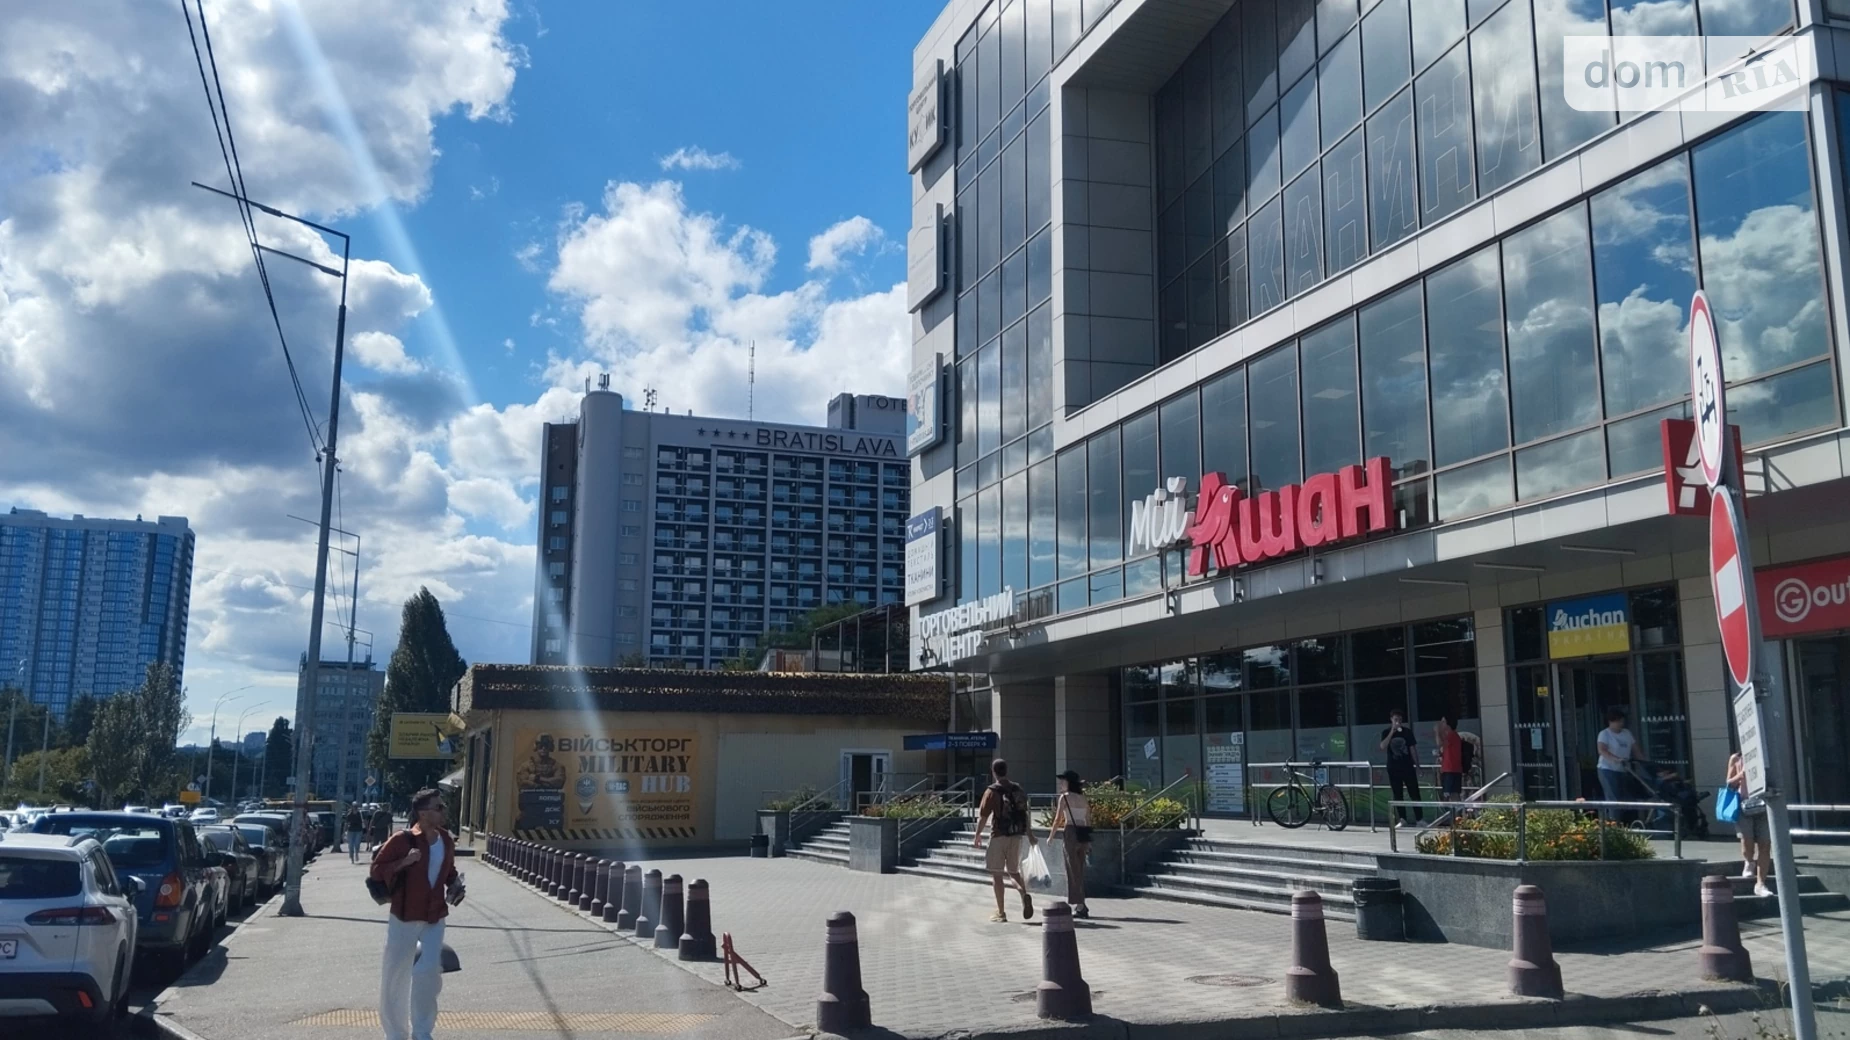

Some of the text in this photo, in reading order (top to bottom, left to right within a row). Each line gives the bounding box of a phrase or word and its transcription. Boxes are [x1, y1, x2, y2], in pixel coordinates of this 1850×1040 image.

[757, 428, 897, 456] BRATISLAVA
[919, 585, 1014, 640] ТОРГОВЕЛЬНИЙ
[1553, 608, 1625, 632] Auchan
[941, 629, 984, 668] ЦЕНТР
[557, 734, 692, 752] ВІЙСЬКТОРГ
[578, 755, 691, 773] MILITARY
[640, 775, 691, 793] HUB
[618, 812, 690, 821] СПОРЯДЖЕННЯ
[626, 803, 690, 812] ВІЙСЬКОВОГО
